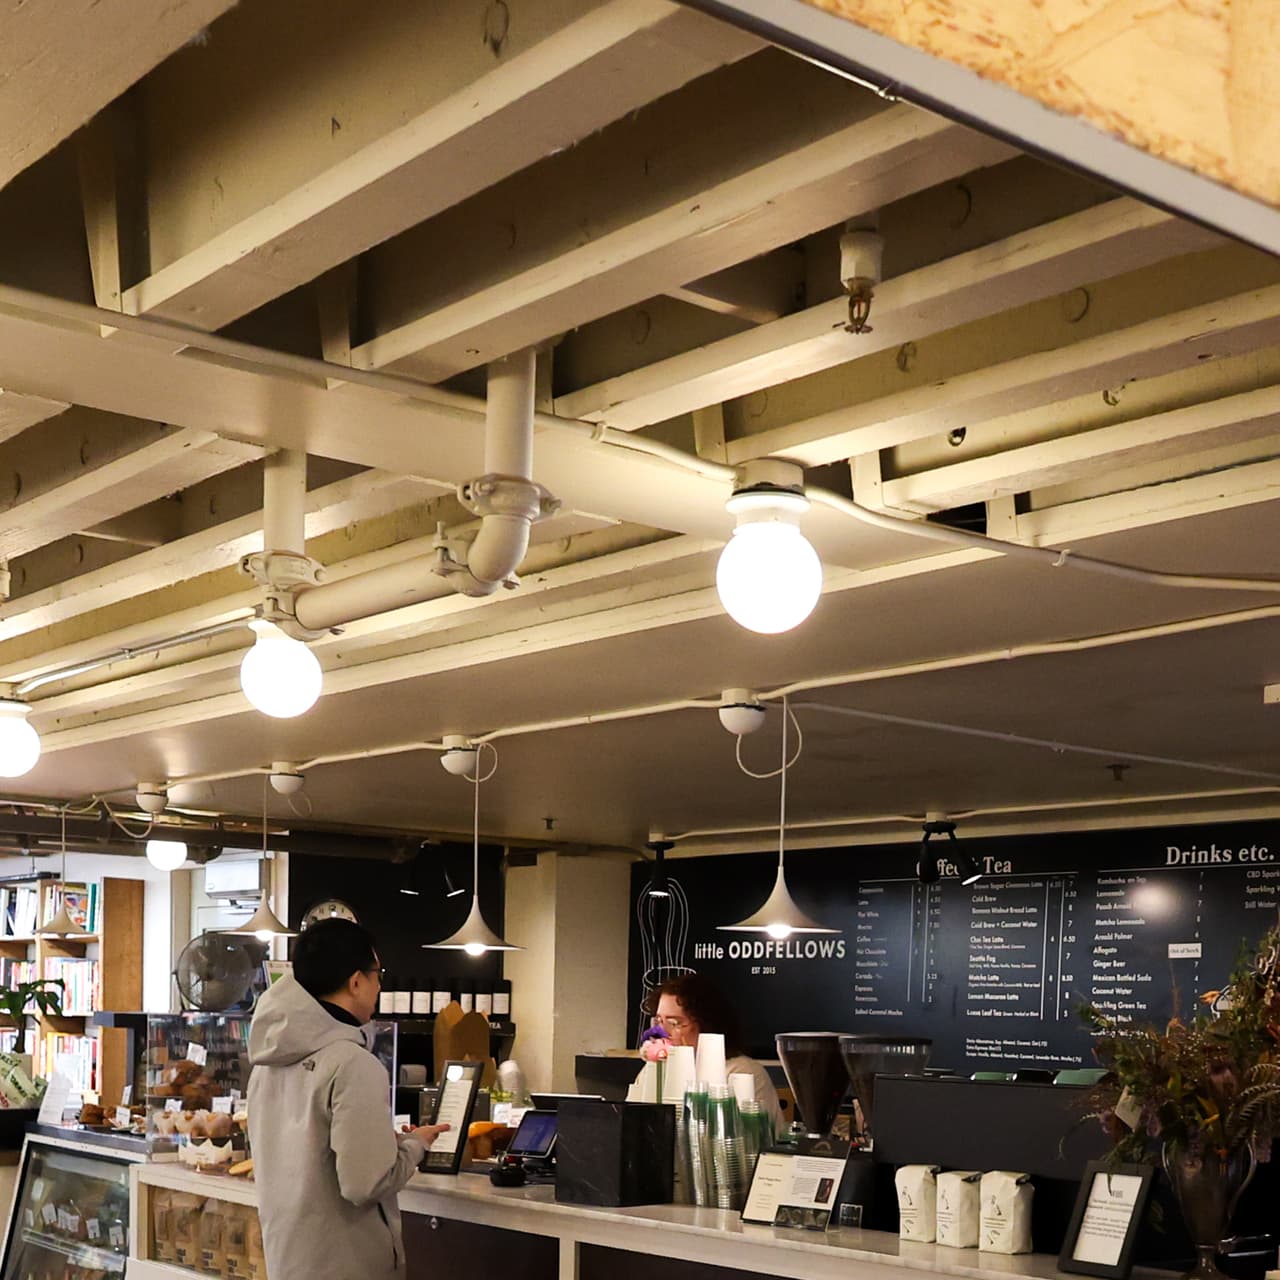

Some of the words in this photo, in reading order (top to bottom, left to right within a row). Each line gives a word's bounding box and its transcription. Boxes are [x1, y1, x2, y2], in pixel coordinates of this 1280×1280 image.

[1166, 844, 1232, 865] Drinks
[1239, 845, 1275, 861] etc.
[983, 856, 1012, 874] Tea
[1246, 884, 1276, 894] Sparkling
[695, 943, 723, 959] little
[728, 940, 846, 959] ODDFELLOWS
[751, 967, 761, 975] EST
[763, 967, 776, 975] 2015
[1093, 960, 1112, 969] Ginger
